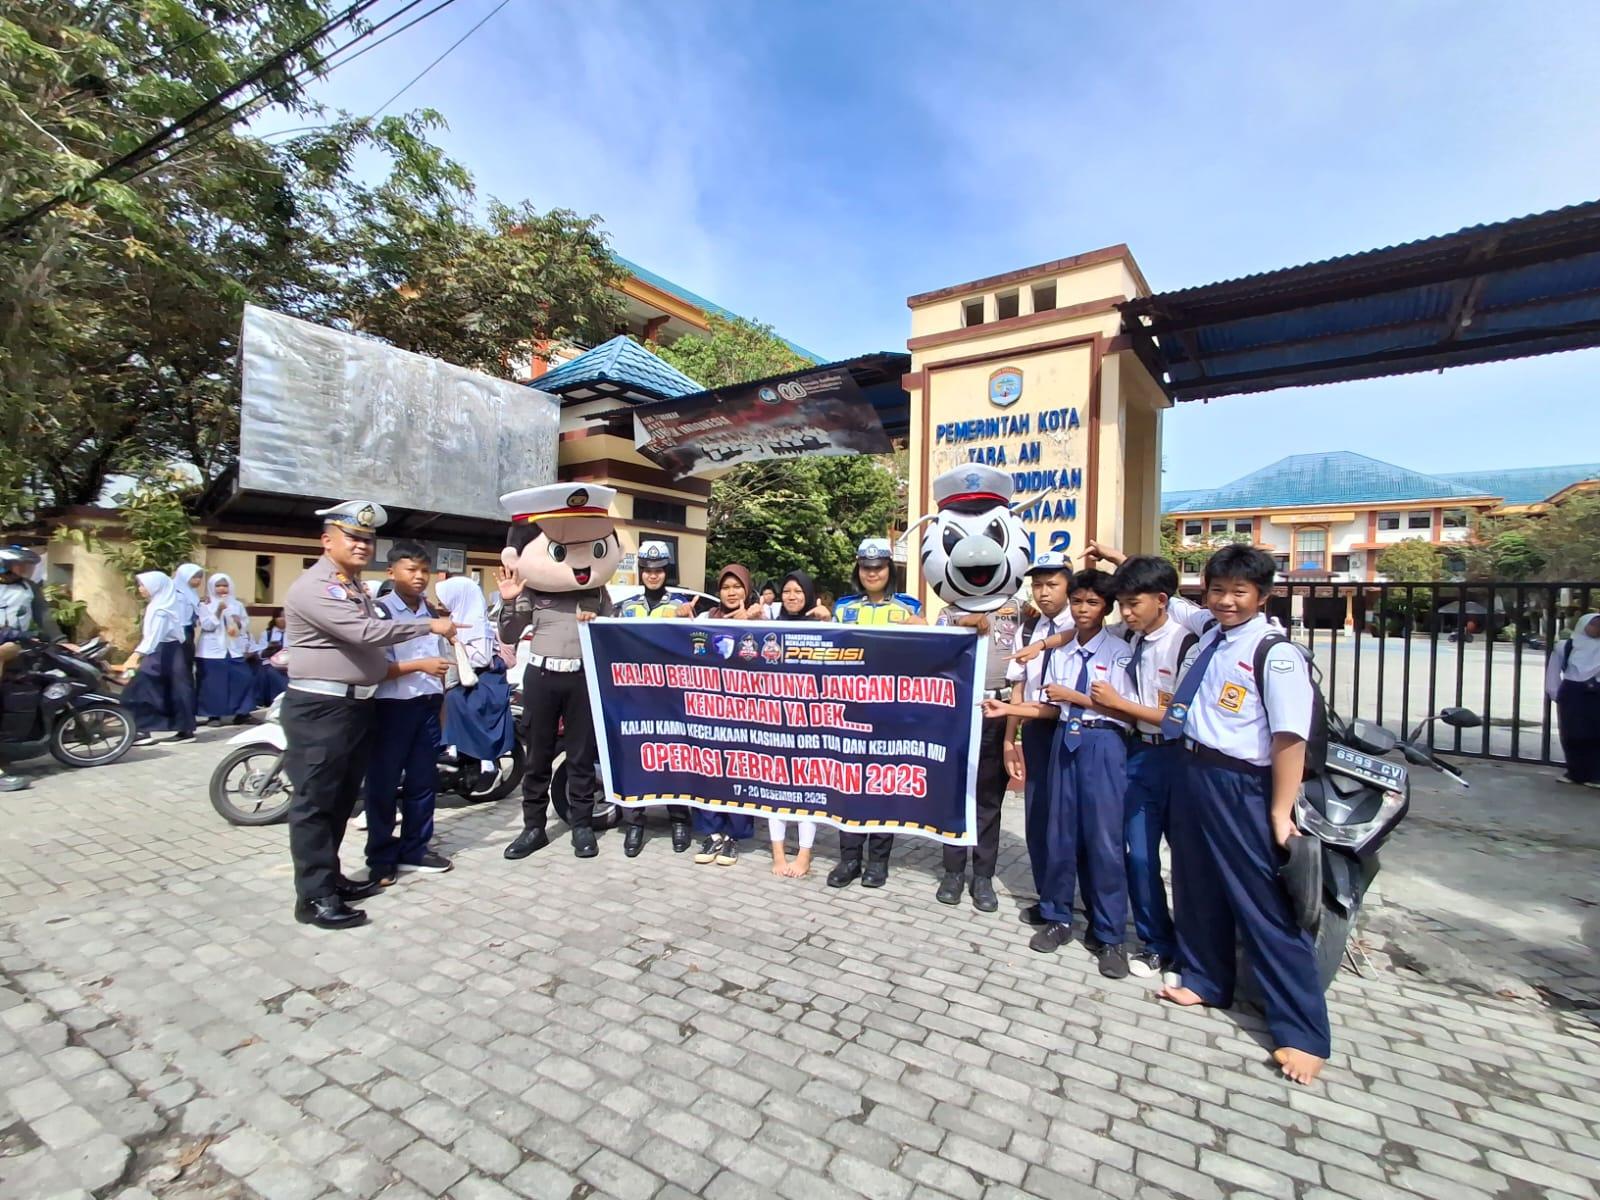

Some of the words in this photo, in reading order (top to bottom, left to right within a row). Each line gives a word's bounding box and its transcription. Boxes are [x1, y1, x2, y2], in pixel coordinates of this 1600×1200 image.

[936, 413, 1030, 444] PEMERINTAH
[1038, 407, 1080, 434] KOTA
[1012, 468, 1082, 493] DIDIKAN
[1008, 499, 1077, 522] AYAAN
[785, 646, 865, 660] PRESISI
[611, 663, 665, 687] KALAU
[665, 664, 721, 691] BELUM
[721, 668, 818, 699] WAKTUNYA
[821, 675, 895, 703] JANGAN
[897, 676, 956, 707] BAWA
[684, 691, 782, 726] KENDARAAN
[784, 701, 809, 727] YA
[620, 720, 654, 736] KALAU
[656, 720, 687, 736] KAMU
[687, 722, 748, 743] KECELAKAAN
[750, 729, 795, 748] KASIHAN
[797, 734, 820, 749] ORG
[821, 734, 841, 752] TUA
[843, 737, 867, 755] DAN
[869, 739, 926, 757] KELUARGA
[927, 742, 947, 762] MU
[641, 742, 723, 777] OPERASI
[724, 750, 790, 786] ZEBRA
[791, 757, 863, 795] KAYAN
[865, 763, 927, 798] 2025
[733, 784, 742, 796] 17
[748, 785, 760, 798] 20
[760, 787, 803, 803] DESEMBER
[804, 791, 827, 805] 2025
